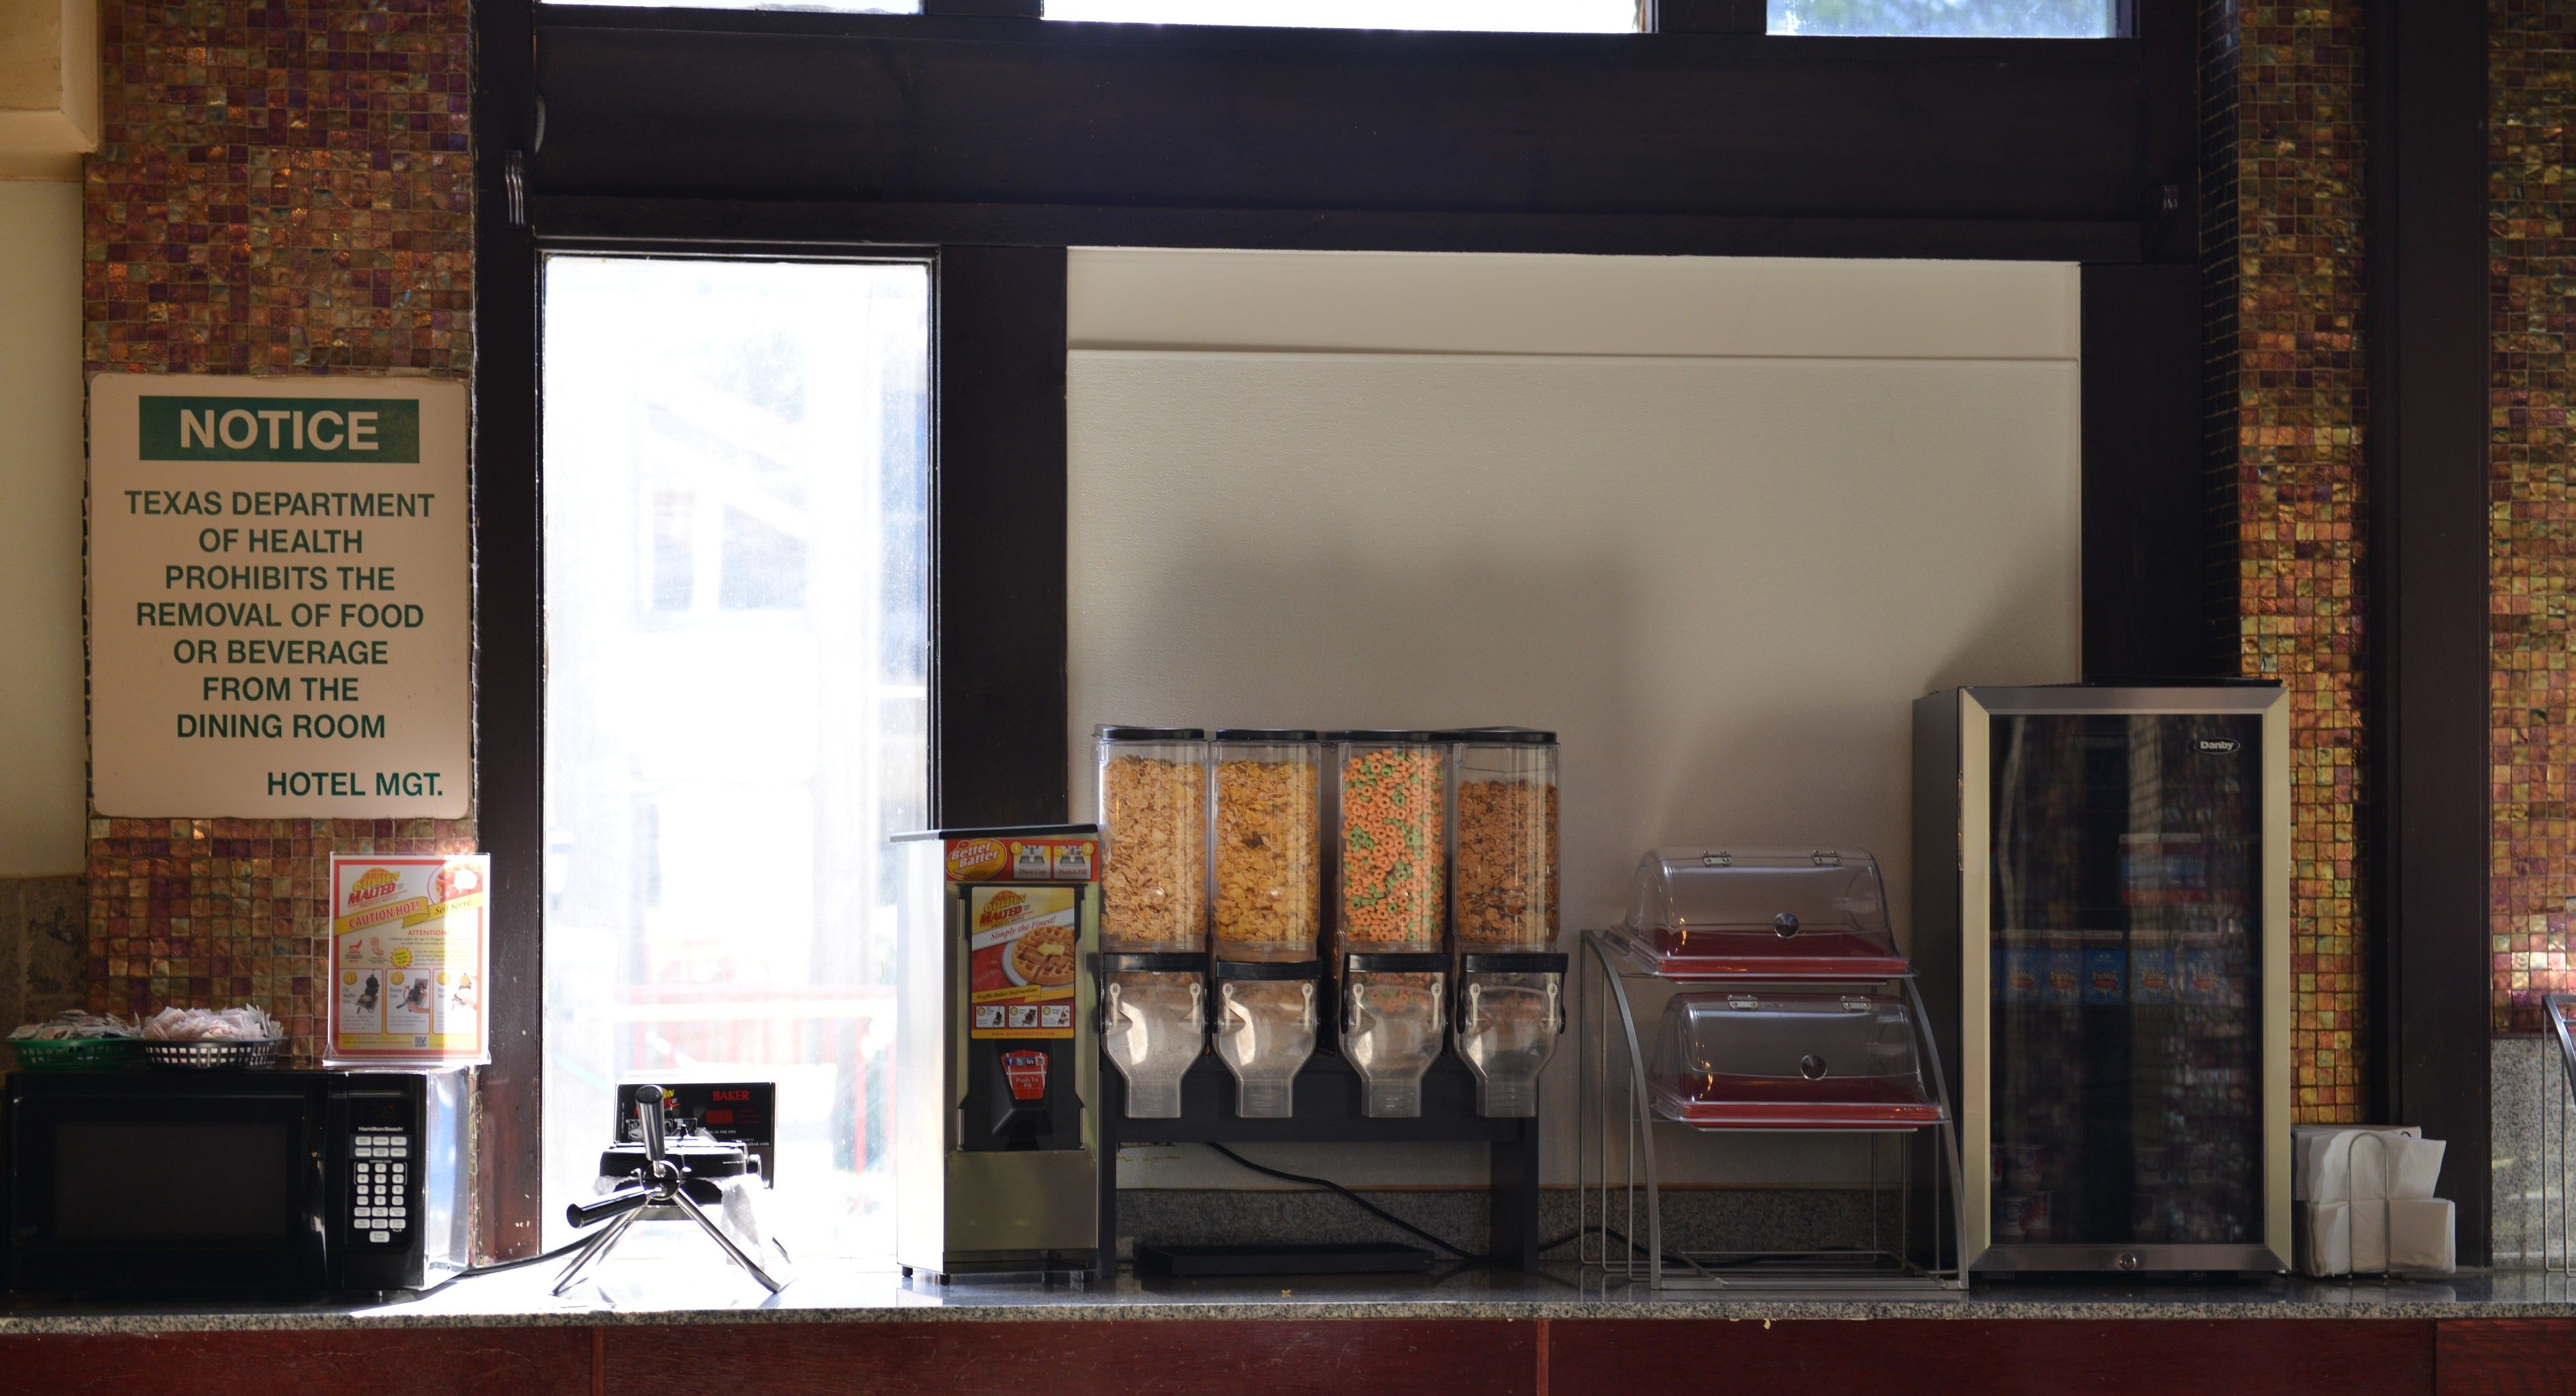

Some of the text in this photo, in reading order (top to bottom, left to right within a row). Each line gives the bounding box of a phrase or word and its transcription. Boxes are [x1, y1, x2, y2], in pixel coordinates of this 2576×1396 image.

[180, 409, 378, 451] NOTICE
[125, 490, 434, 517] TEXAS DEPARTMENT
[199, 529, 362, 553] OF HEALTH
[166, 566, 394, 590] PROHIBITS THE
[137, 602, 424, 628] REMOVAL OF FOOD
[173, 640, 388, 664] OR BEVERAGE
[203, 678, 358, 701] FROM THE
[178, 714, 385, 738] DINING ROOM
[2200, 741, 2233, 751] Danby
[267, 772, 442, 796] HOTEL MGT.
[951, 841, 992, 861] Better
[959, 850, 999, 868] Batter
[352, 869, 400, 892] GOLDEN
[348, 881, 396, 904] MALTED
[349, 901, 420, 928] CAUTION HOT!
[980, 905, 1023, 925] MALTED
[990, 916, 1057, 940] Simply the Finest!
[2008, 969, 2035, 981] TruMoo
[2049, 970, 2077, 981] TruMoo
[2092, 970, 2118, 981] TruMoo
[2141, 970, 2168, 981] TruMoo
[2192, 971, 2219, 981] TruMoo
[712, 1090, 749, 1101] BAKER
